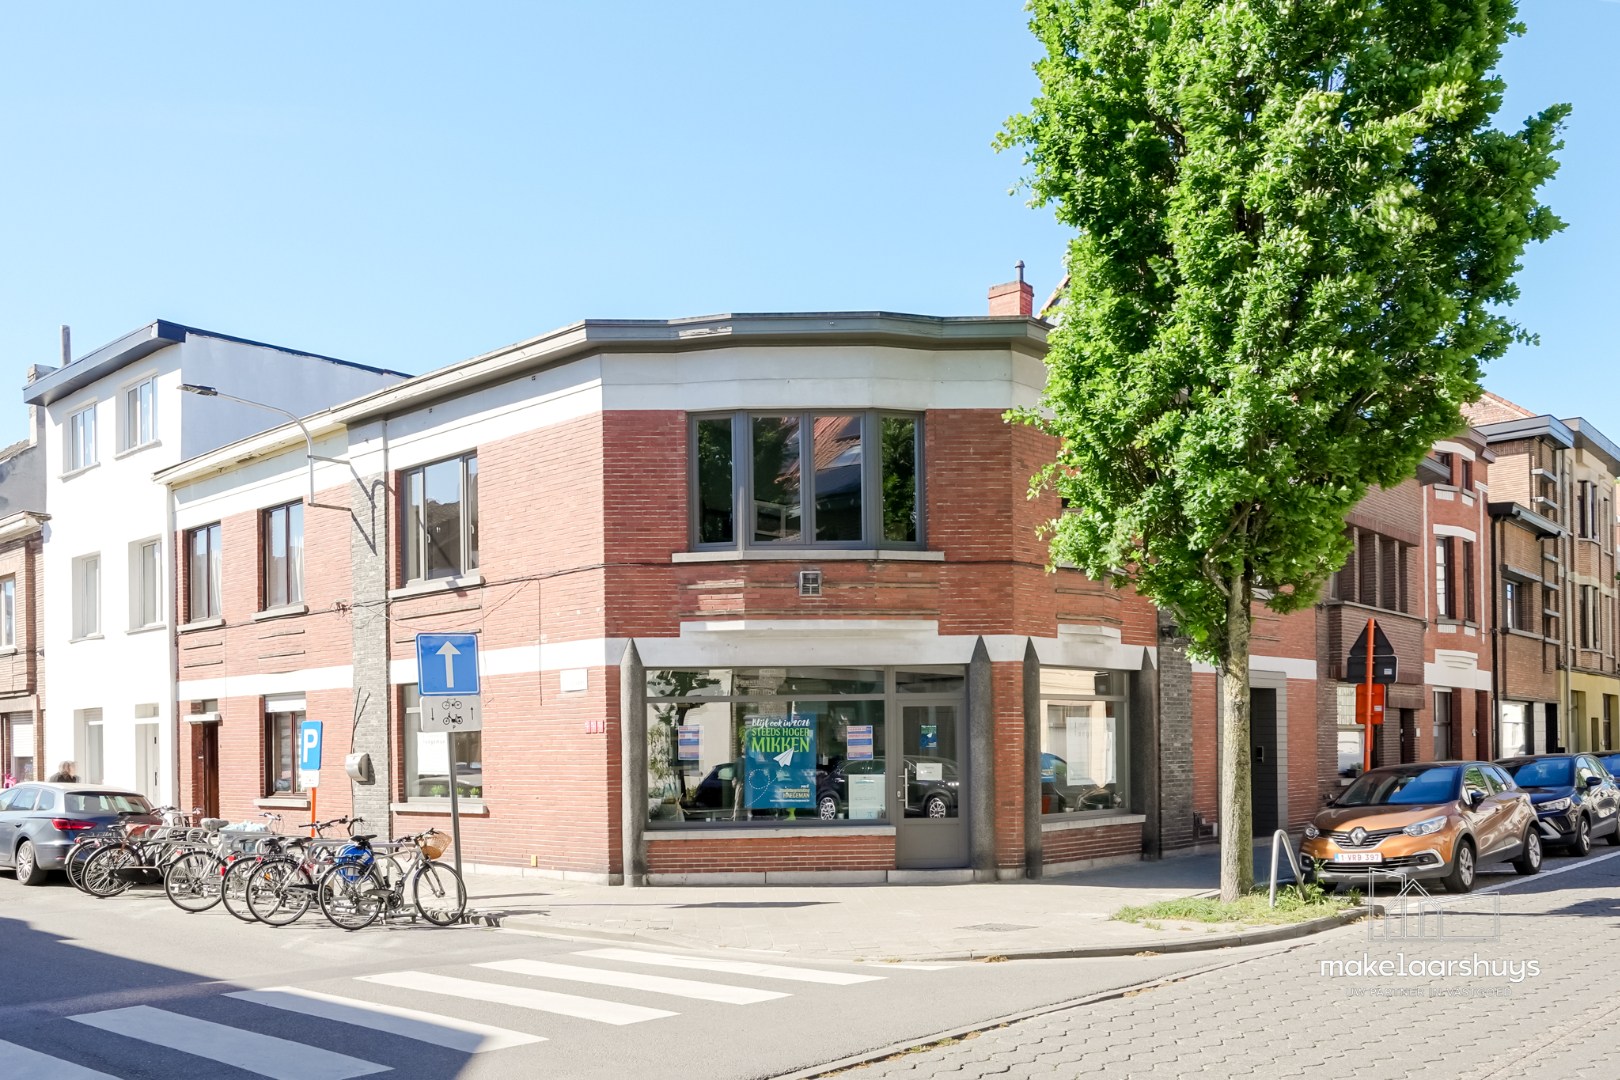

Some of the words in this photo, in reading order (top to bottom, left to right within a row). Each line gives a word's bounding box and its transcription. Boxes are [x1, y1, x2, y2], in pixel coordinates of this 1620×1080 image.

[770, 718, 782, 727] ook
[783, 719, 792, 727] in
[751, 728, 781, 736] STEEDS
[782, 728, 810, 736] HOGER
[302, 728, 318, 763] P
[751, 737, 810, 753] MIKKEN
